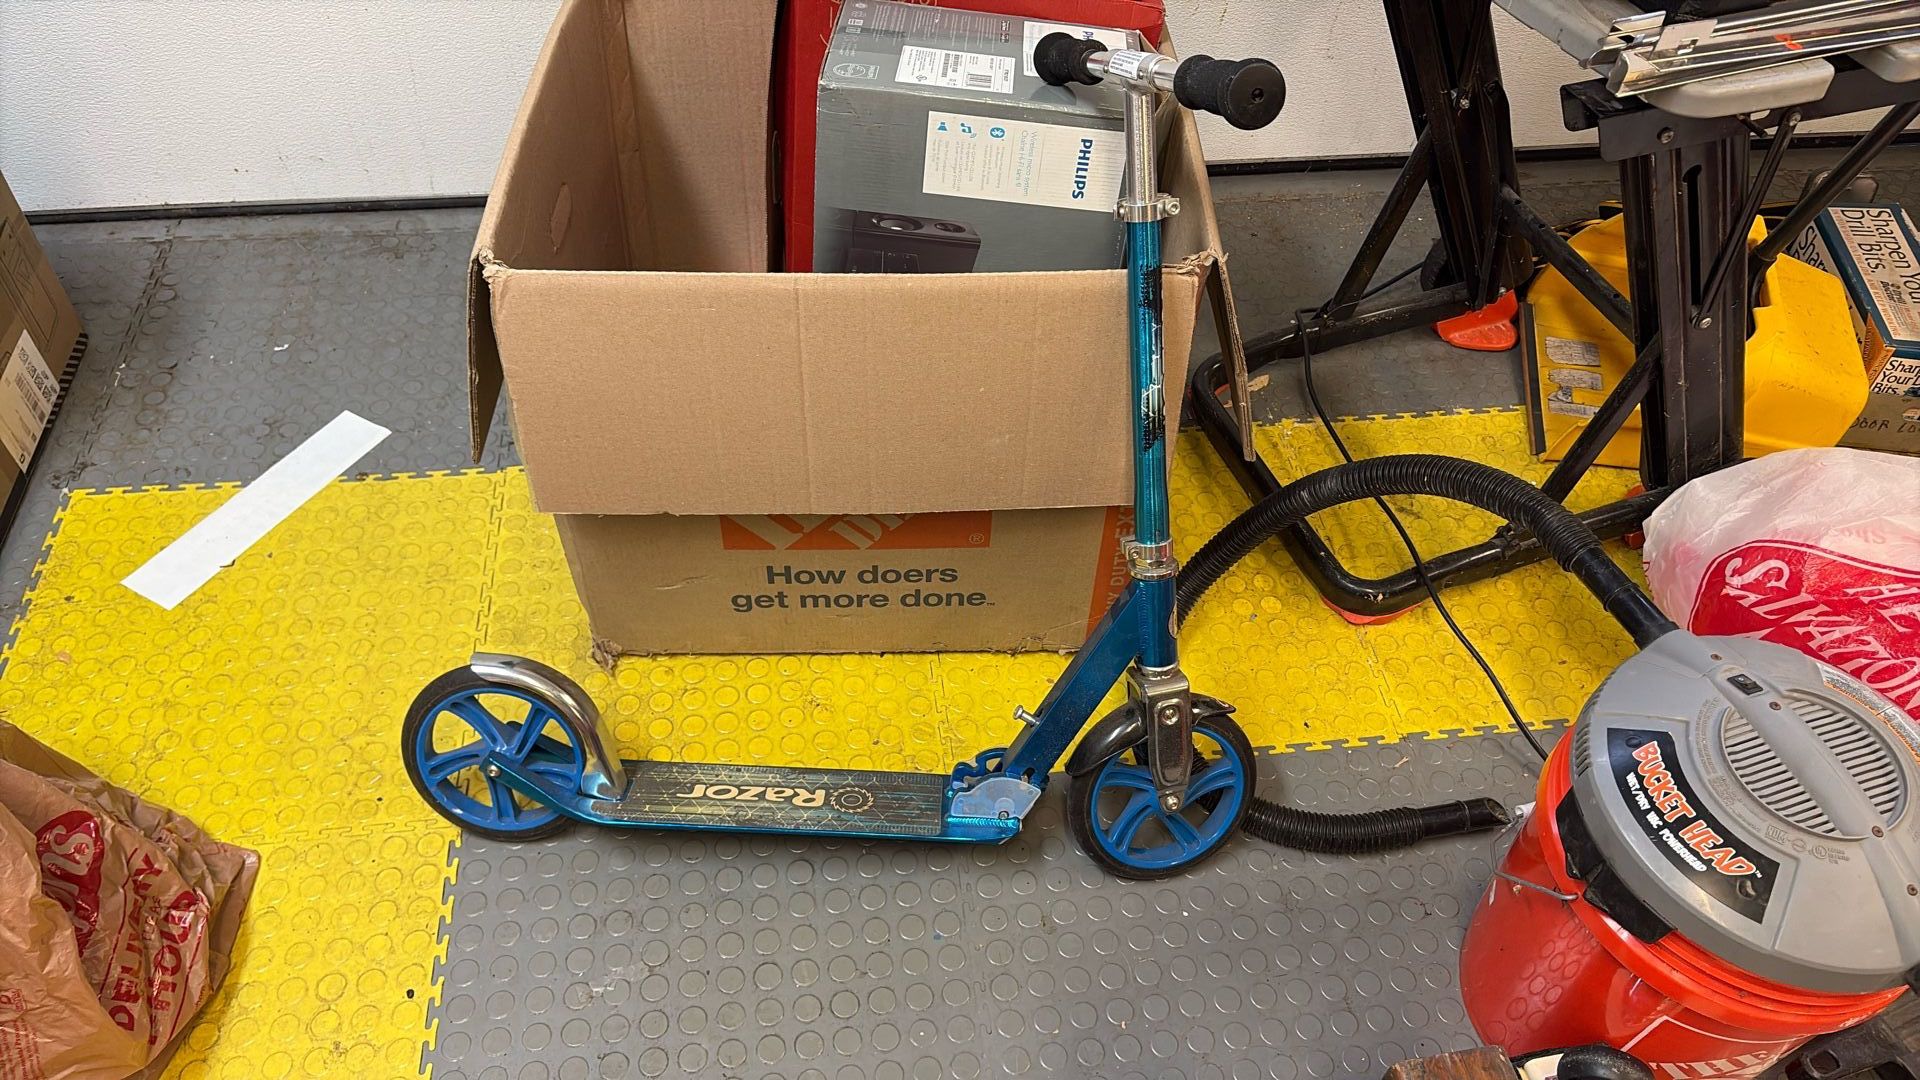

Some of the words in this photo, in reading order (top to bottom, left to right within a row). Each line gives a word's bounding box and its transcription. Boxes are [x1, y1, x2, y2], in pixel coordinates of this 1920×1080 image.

[1072, 138, 1094, 200] PHILIPS
[1841, 209, 1877, 237] Drill
[1799, 225, 1828, 272] Shar
[1866, 209, 1912, 269] Sharpen
[1858, 242, 1886, 273] Bits.
[1871, 382, 1900, 396] Bits.
[1880, 370, 1914, 385] Your
[766, 565, 846, 585] How
[857, 563, 959, 584] doers
[731, 590, 790, 613] get
[799, 591, 890, 609] more
[1842, 583, 1920, 632] HE
[676, 783, 826, 808] Razor
[1631, 740, 1697, 823] BUCKET
[1678, 819, 1757, 876] HEAD
[1625, 771, 1651, 811] WET/DRY
[1646, 810, 1664, 829] VAC
[1658, 827, 1708, 872] POWERHEAD
